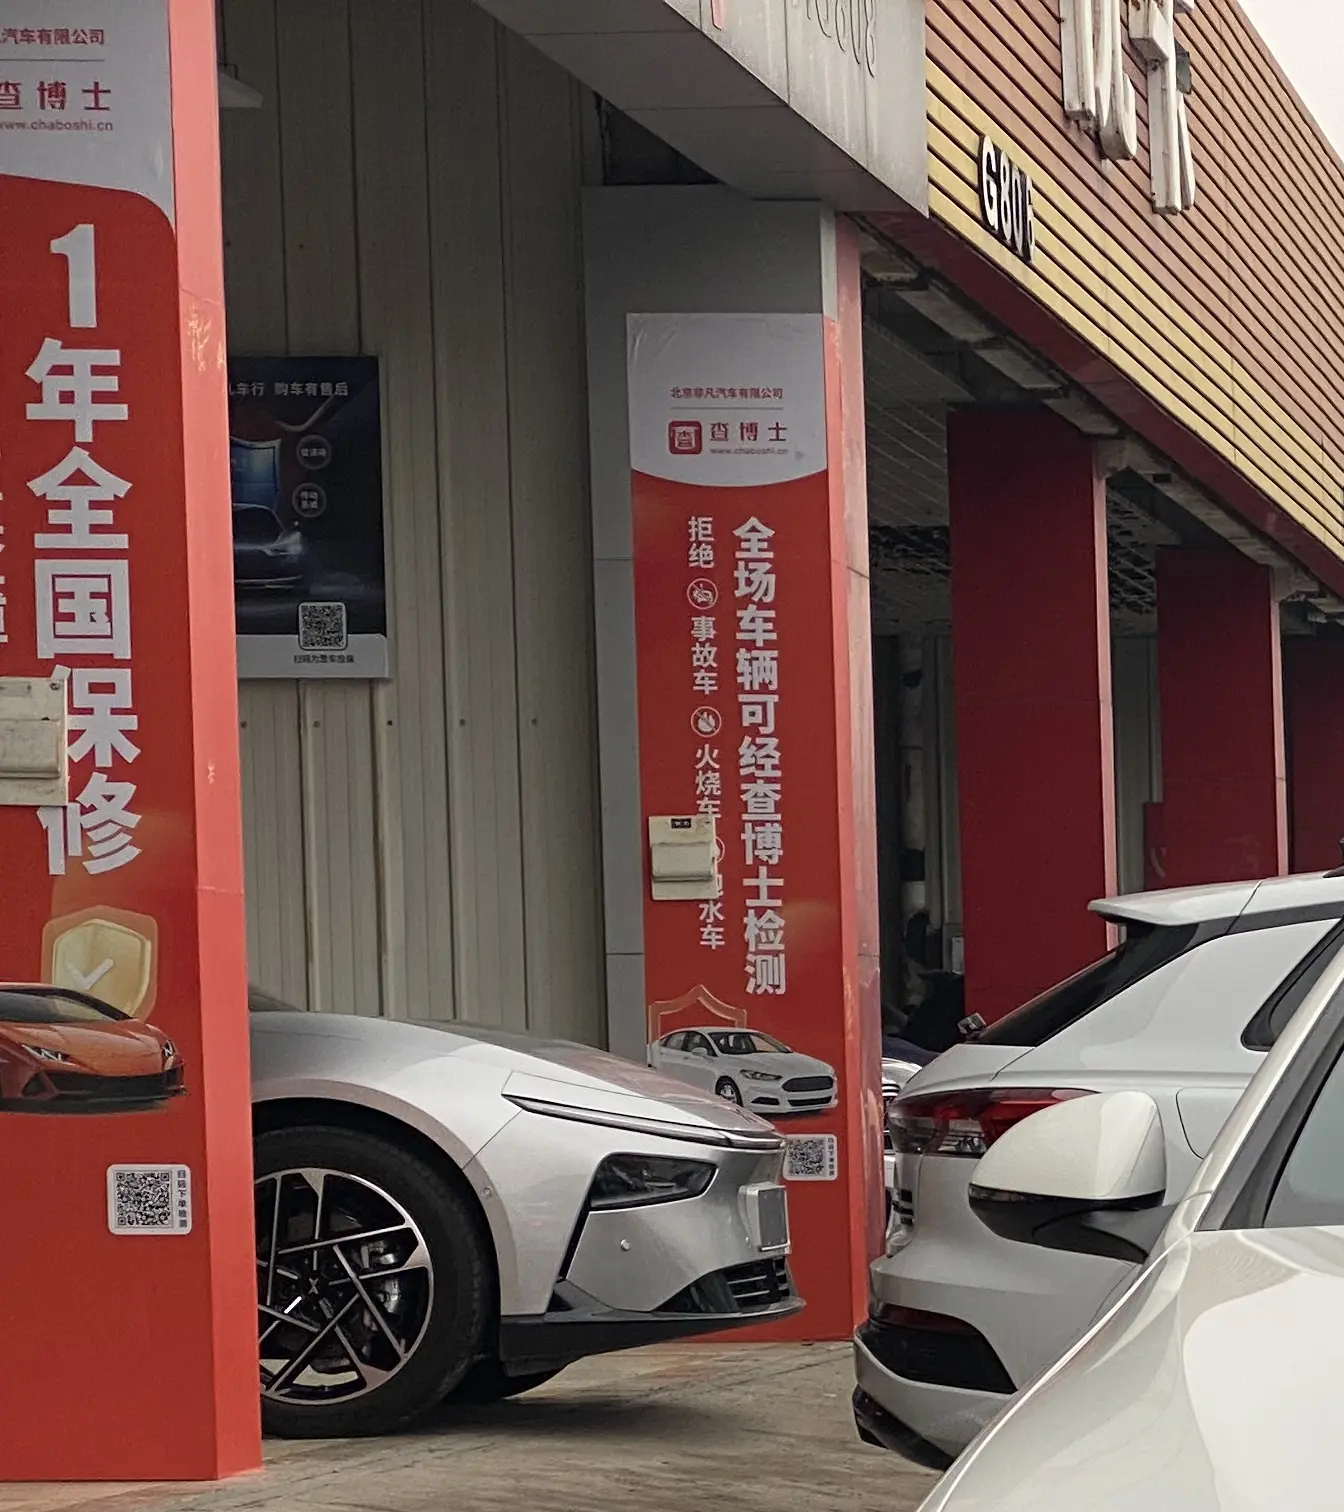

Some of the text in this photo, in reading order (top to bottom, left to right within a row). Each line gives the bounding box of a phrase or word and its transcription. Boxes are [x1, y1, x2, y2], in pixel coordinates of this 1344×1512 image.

[0, 28, 105, 45] 汽车有限公司
[0, 81, 112, 111] 查博士
[229, 382, 349, 396] 车行 购车有售后
[670, 386, 783, 399] 北京非凡汽车有限公司
[709, 422, 788, 442] 查博士
[26, 223, 143, 876] 1年全国保修
[687, 516, 716, 570] 拒绝
[690, 615, 719, 696] 事故车
[731, 515, 787, 996] 全场车辆可经查博士检测
